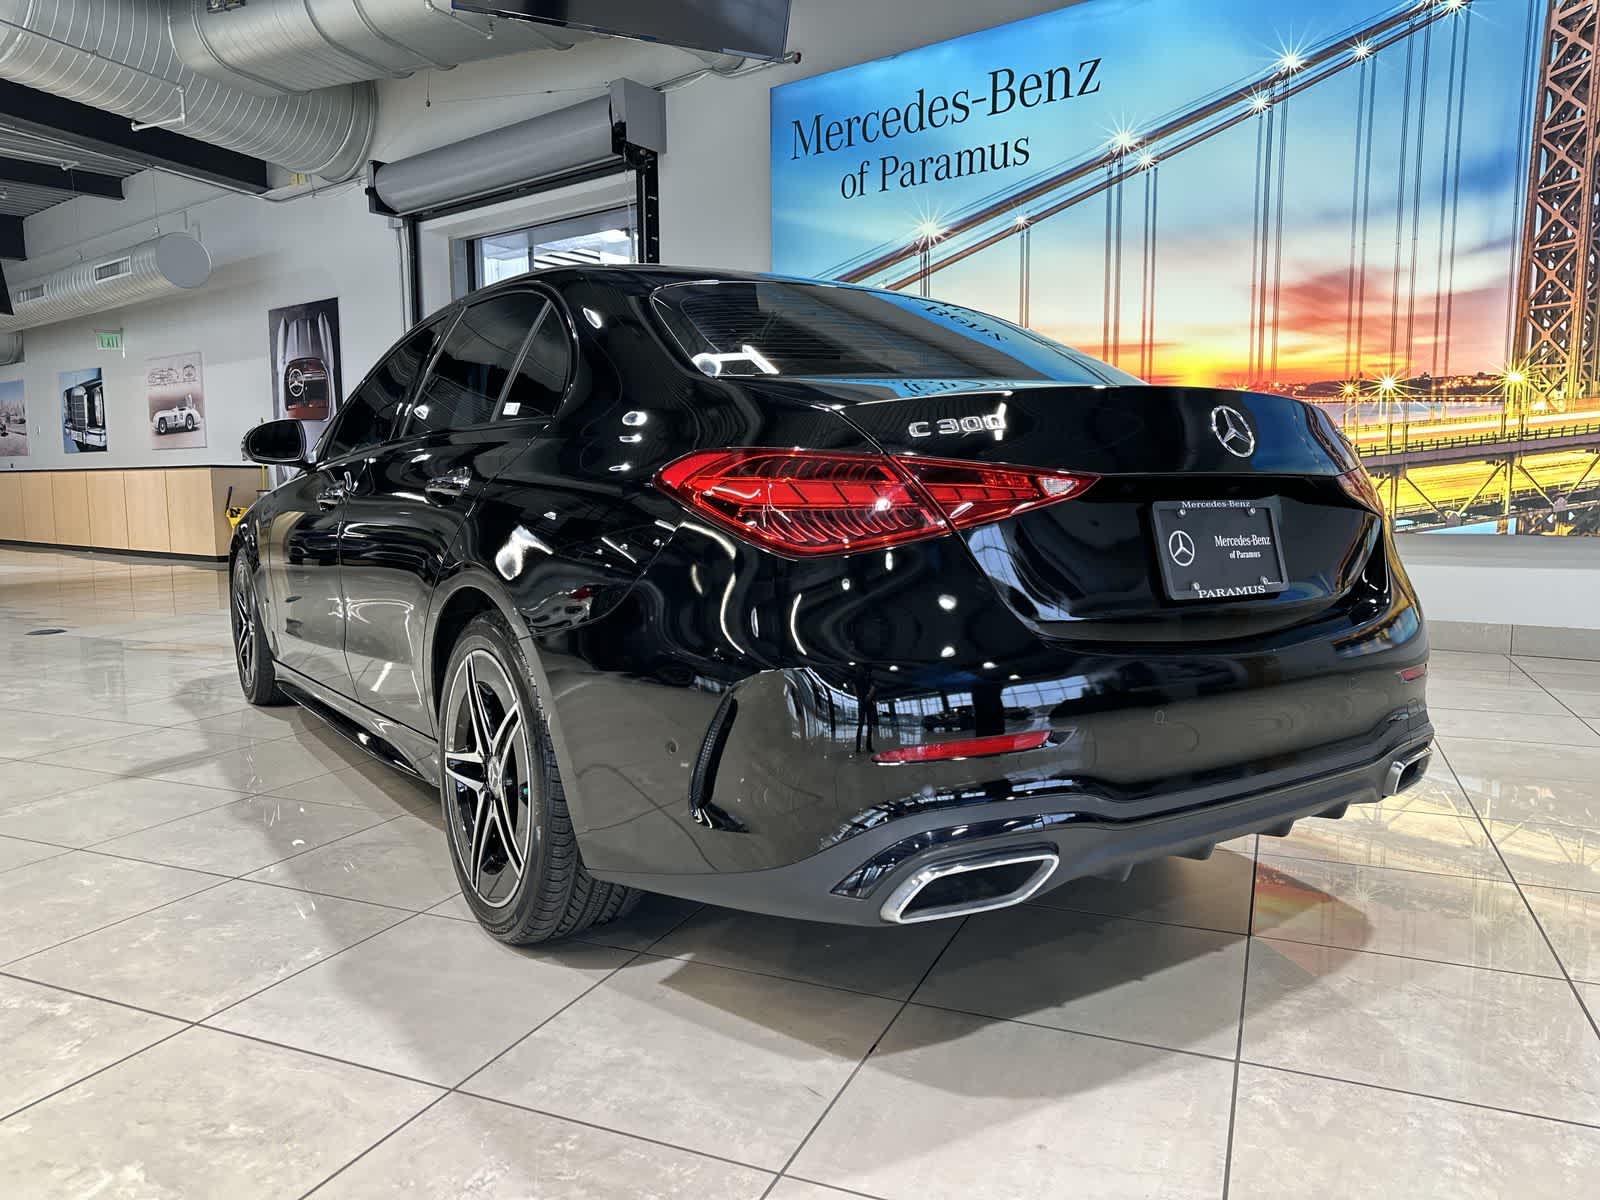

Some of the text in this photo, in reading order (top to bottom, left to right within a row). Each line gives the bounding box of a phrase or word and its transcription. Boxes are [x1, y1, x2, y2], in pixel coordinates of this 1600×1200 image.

[791, 57, 1102, 160] Mercedes-Benz
[840, 136, 1030, 200] of Paramus
[908, 414, 1006, 438] C 300
[1181, 500, 1251, 509] Mercedes-Benz
[1214, 534, 1272, 547] Mercedes-Benz
[1229, 550, 1262, 559] of Paramus
[1198, 585, 1266, 599] PARAMUS
